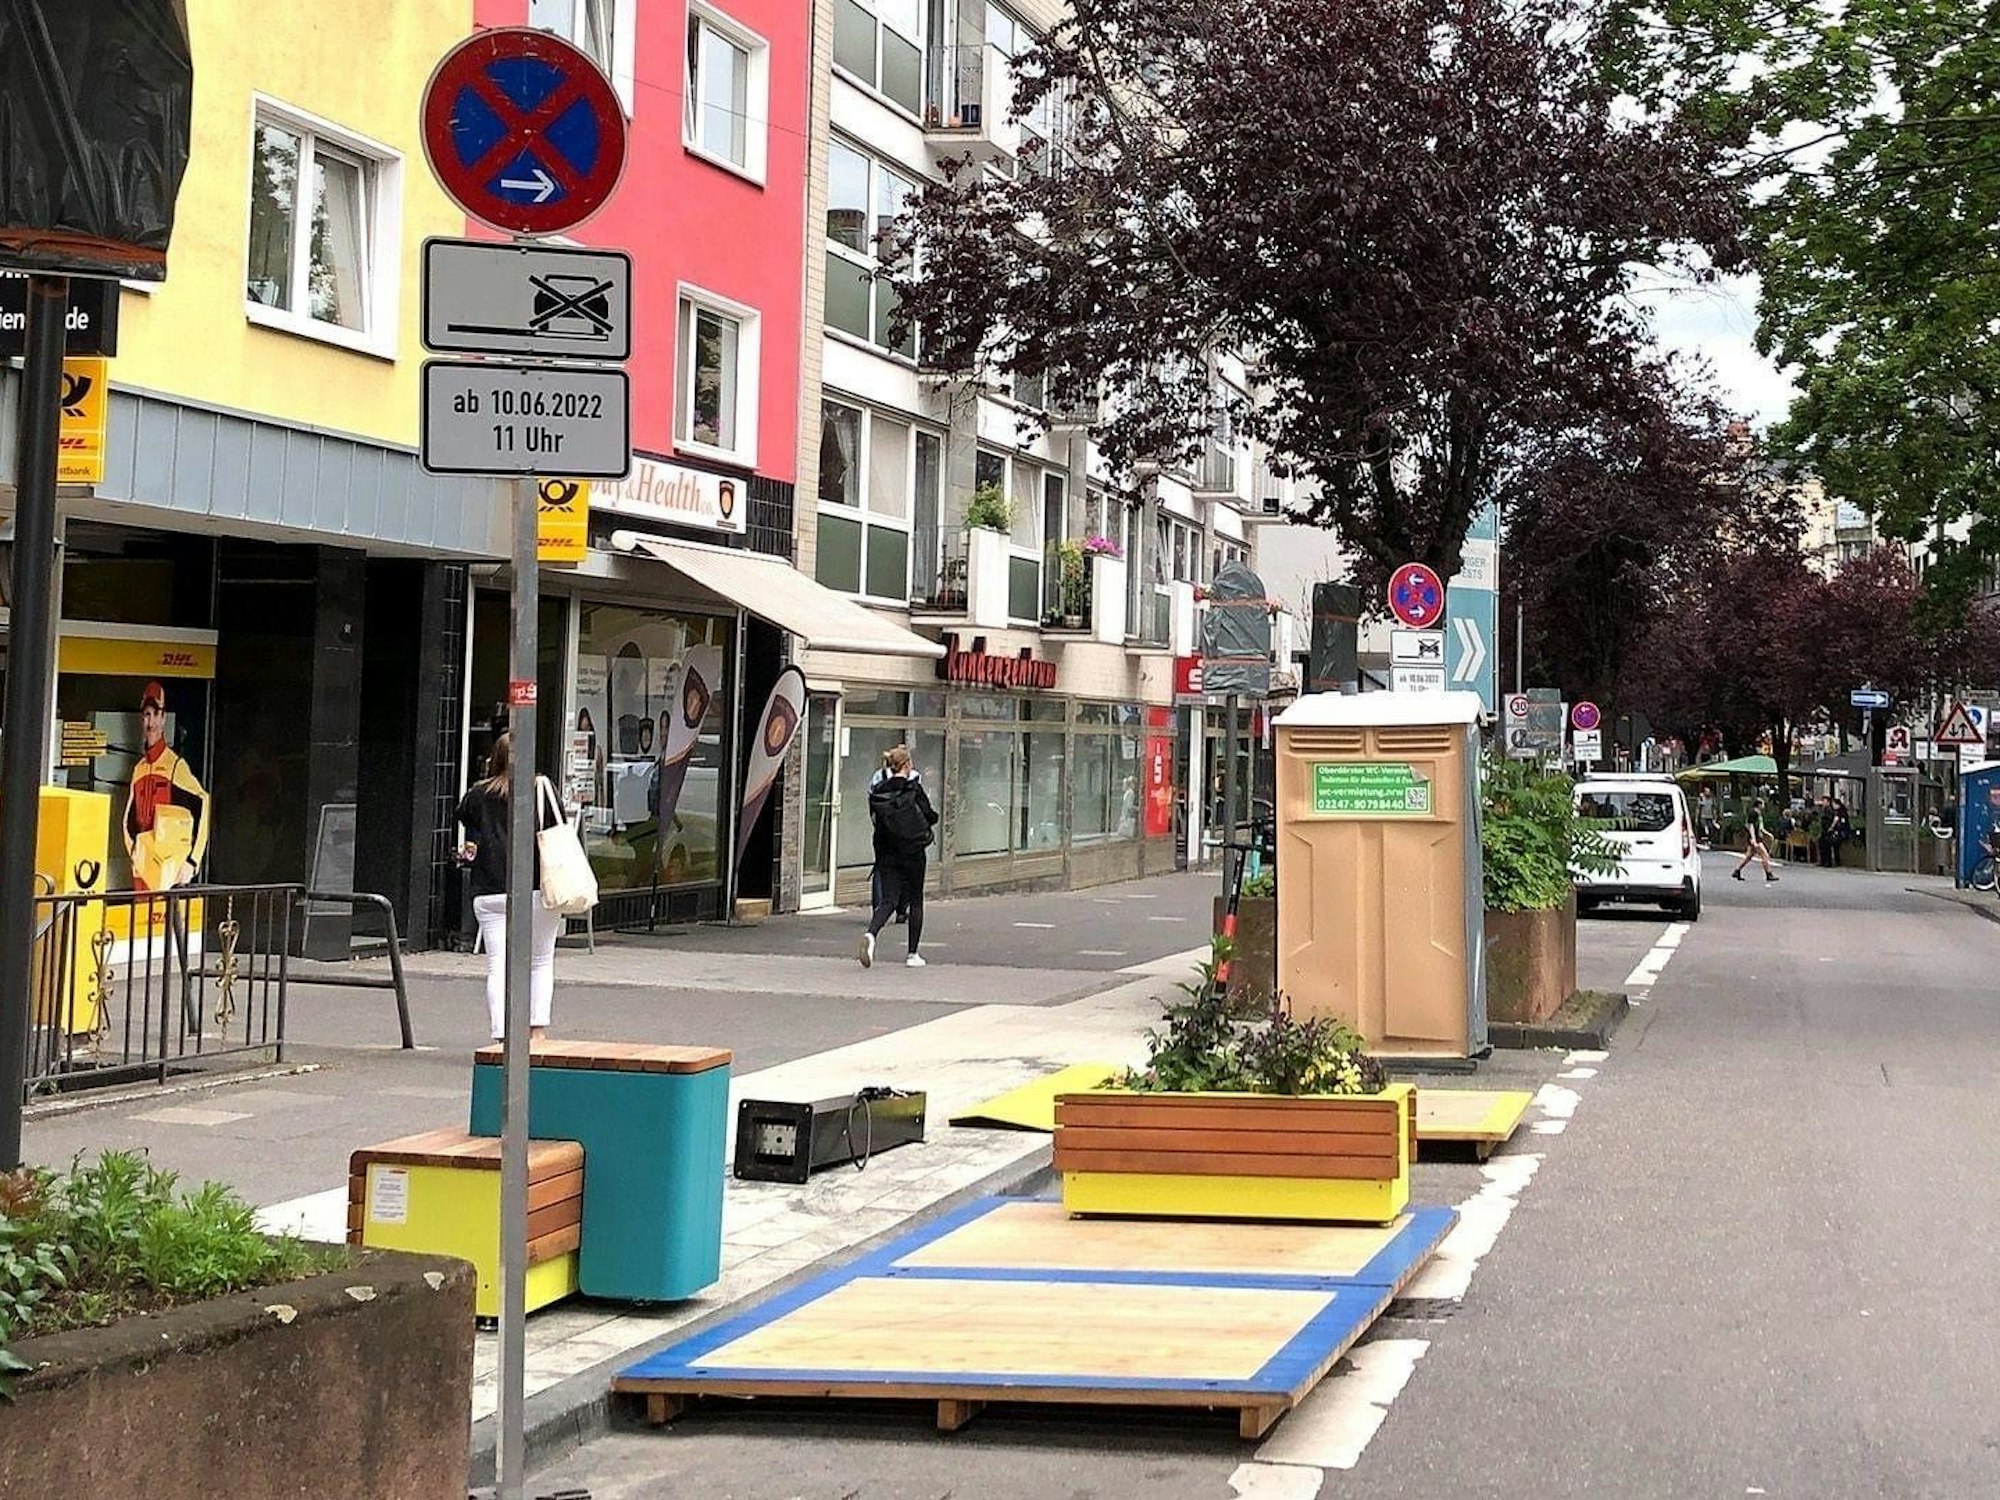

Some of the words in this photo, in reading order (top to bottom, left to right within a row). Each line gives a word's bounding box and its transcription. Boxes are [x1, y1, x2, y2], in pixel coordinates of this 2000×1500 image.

[453, 389, 479, 414] ab
[491, 390, 603, 419] 10.06.2022
[493, 425, 514, 451] 11
[526, 427, 564, 453] Uhr
[161, 653, 194, 666] DHL
[1514, 701, 1526, 712] 30
